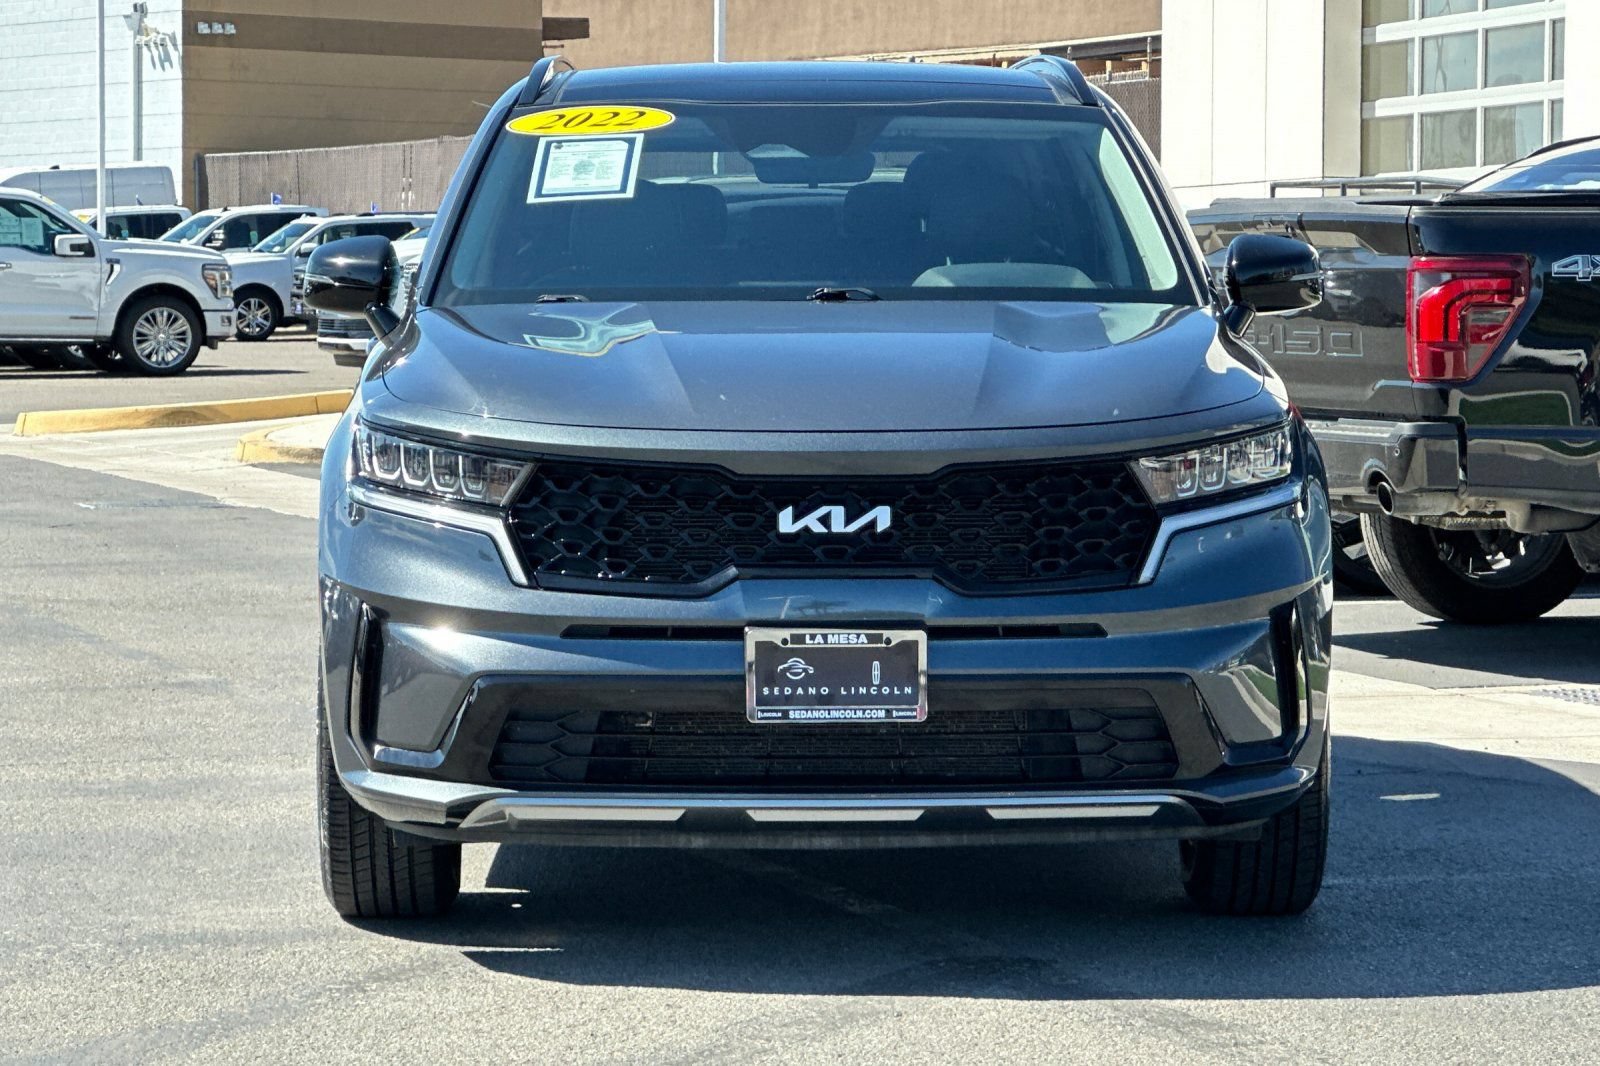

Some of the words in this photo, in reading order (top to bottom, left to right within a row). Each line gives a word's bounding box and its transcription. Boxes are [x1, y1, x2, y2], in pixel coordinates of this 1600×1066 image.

[533, 110, 647, 131] 2022
[778, 505, 891, 534] KIA
[805, 634, 822, 644] LA
[827, 634, 868, 644] MESA
[762, 686, 829, 695] SEDANO
[840, 686, 912, 695] LINCOLN
[788, 709, 886, 719] SEDANOLINCOLN.COM
